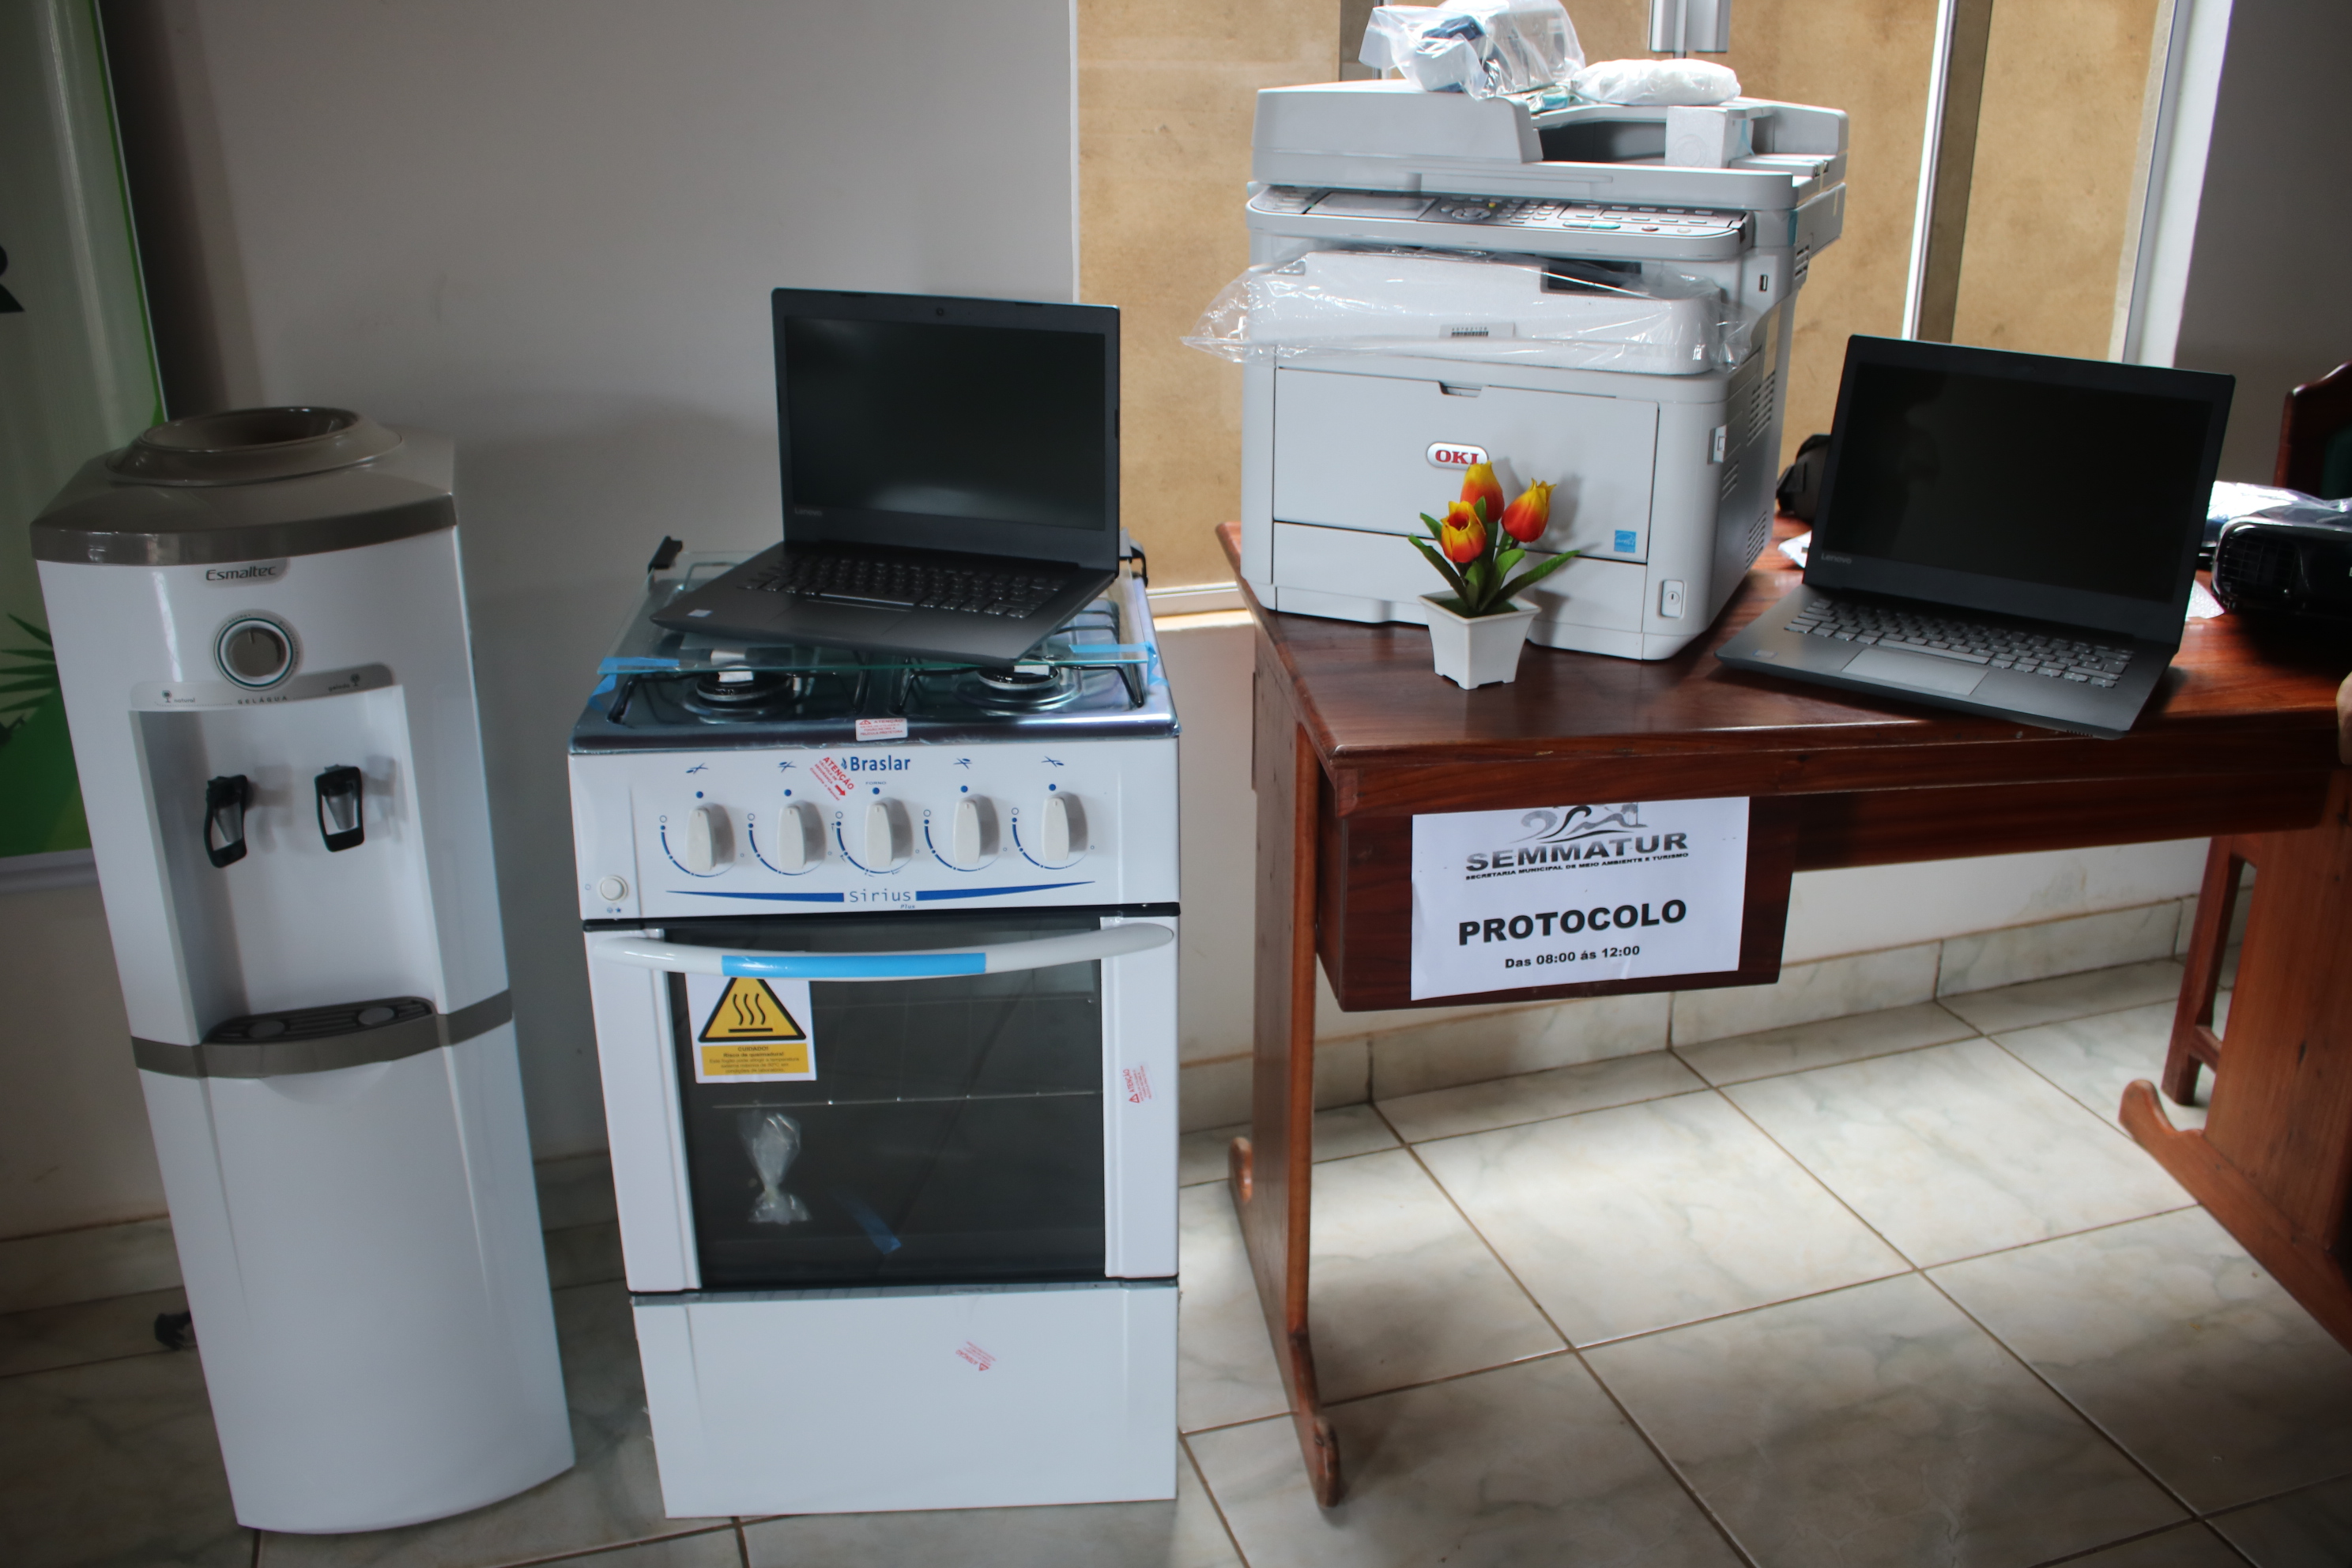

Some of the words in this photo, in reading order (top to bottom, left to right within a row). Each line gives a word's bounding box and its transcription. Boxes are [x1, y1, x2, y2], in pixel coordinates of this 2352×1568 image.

[1435, 450, 1479, 465] OKI
[794, 507, 823, 517] Lenovo
[1821, 552, 1852, 564] Lenovo
[205, 566, 277, 581] Esmaltec
[850, 755, 910, 771] Braslar
[823, 756, 854, 790] ATENÇÃO
[1466, 832, 1688, 872] SEMMATUR
[1466, 870, 1516, 880] SECRETARIA
[1518, 865, 1563, 874] MUNICIPAL
[1601, 858, 1643, 866] AMBIENTE
[850, 888, 911, 903] Sirius
[1459, 899, 1687, 945] PROTOCOLO
[1505, 957, 1532, 969] Das
[1536, 952, 1576, 965] 08:00
[1601, 945, 1640, 958] 12:00
